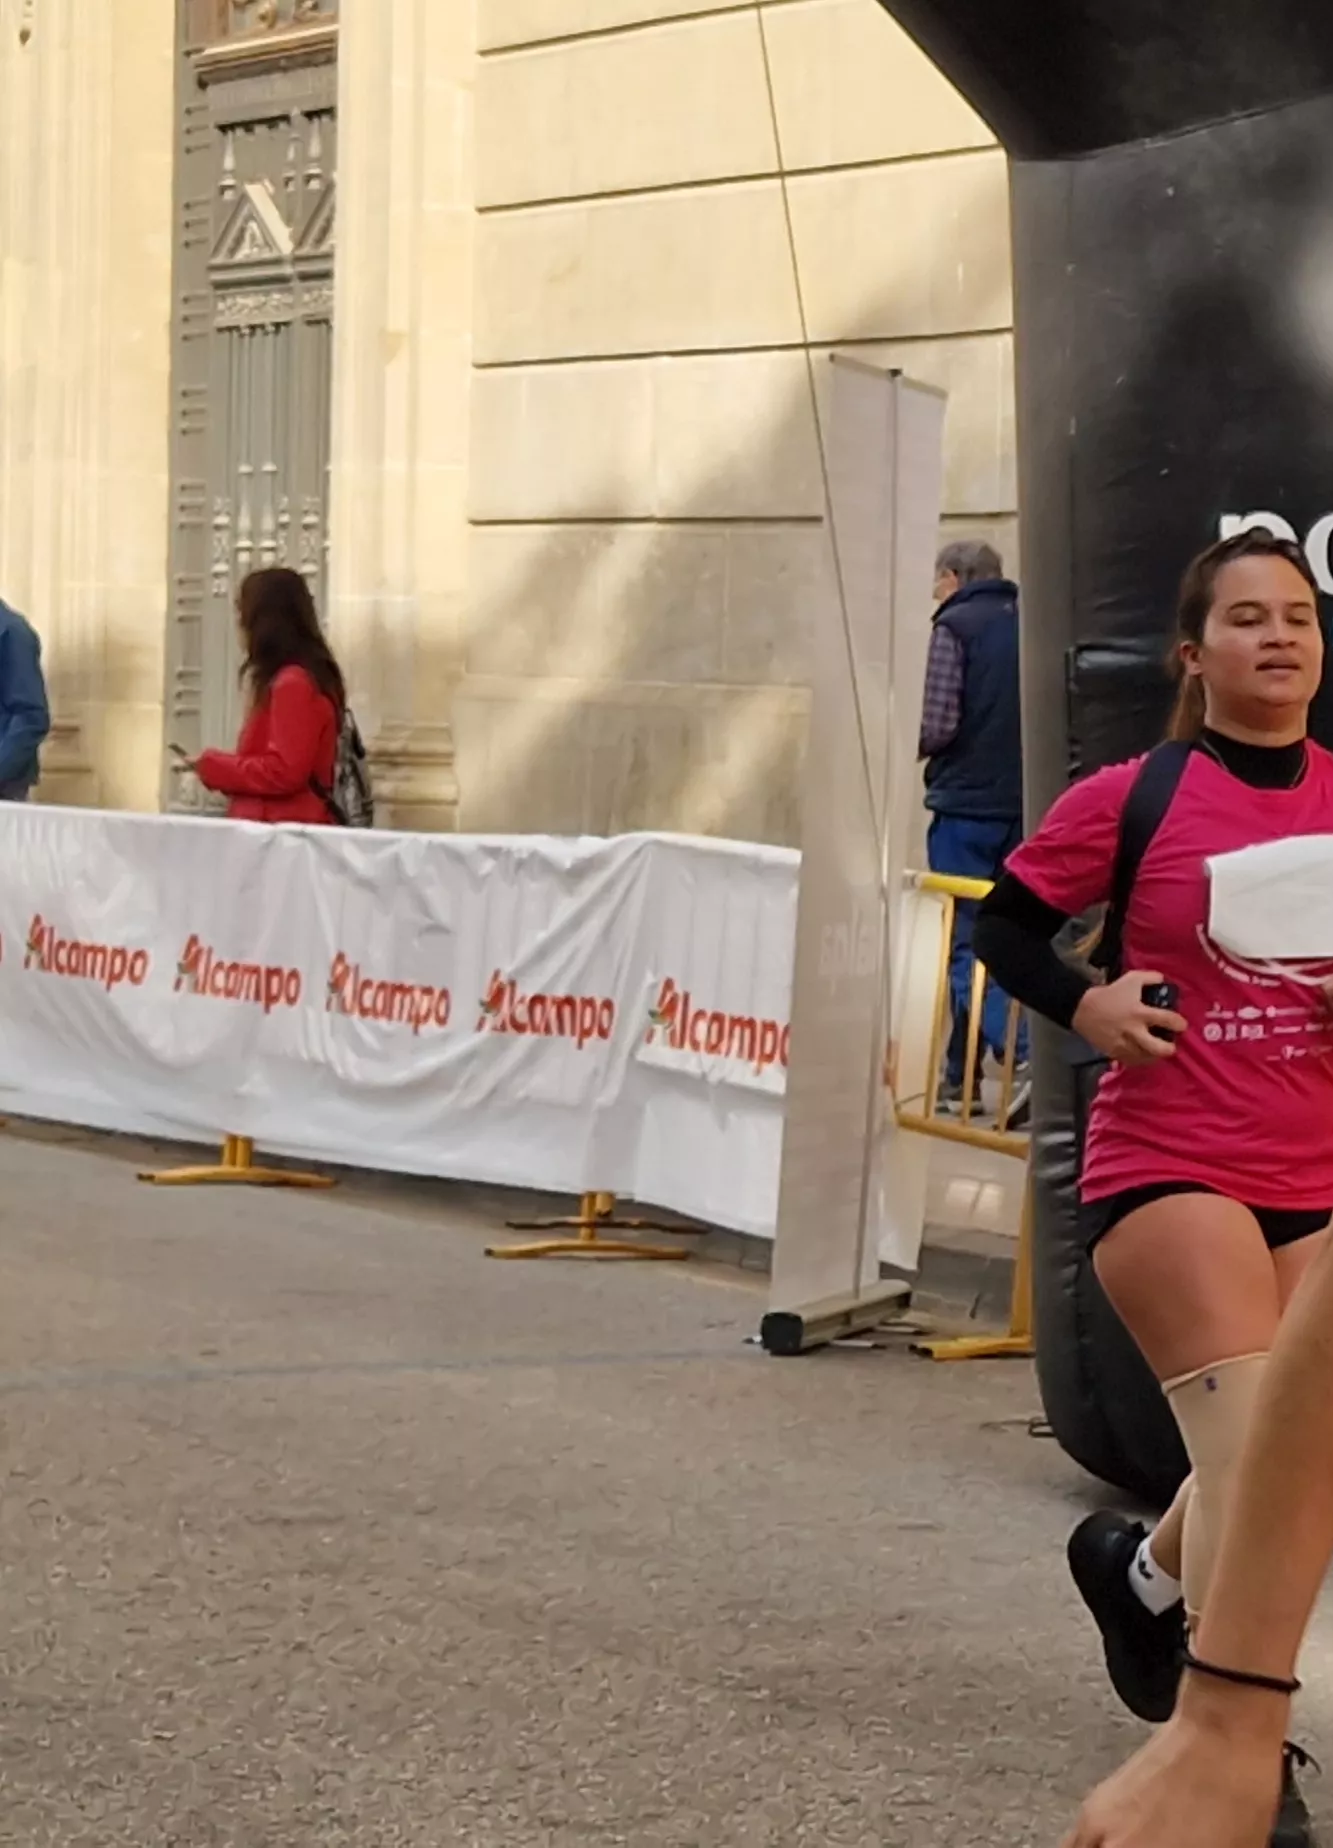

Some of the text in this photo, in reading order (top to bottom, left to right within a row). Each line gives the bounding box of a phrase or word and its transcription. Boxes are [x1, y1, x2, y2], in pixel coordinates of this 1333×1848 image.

[24, 914, 149, 992] Alcampo
[173, 934, 302, 1015] Alcampo
[326, 951, 451, 1035] Alcampo
[476, 968, 614, 1050] Alcampo
